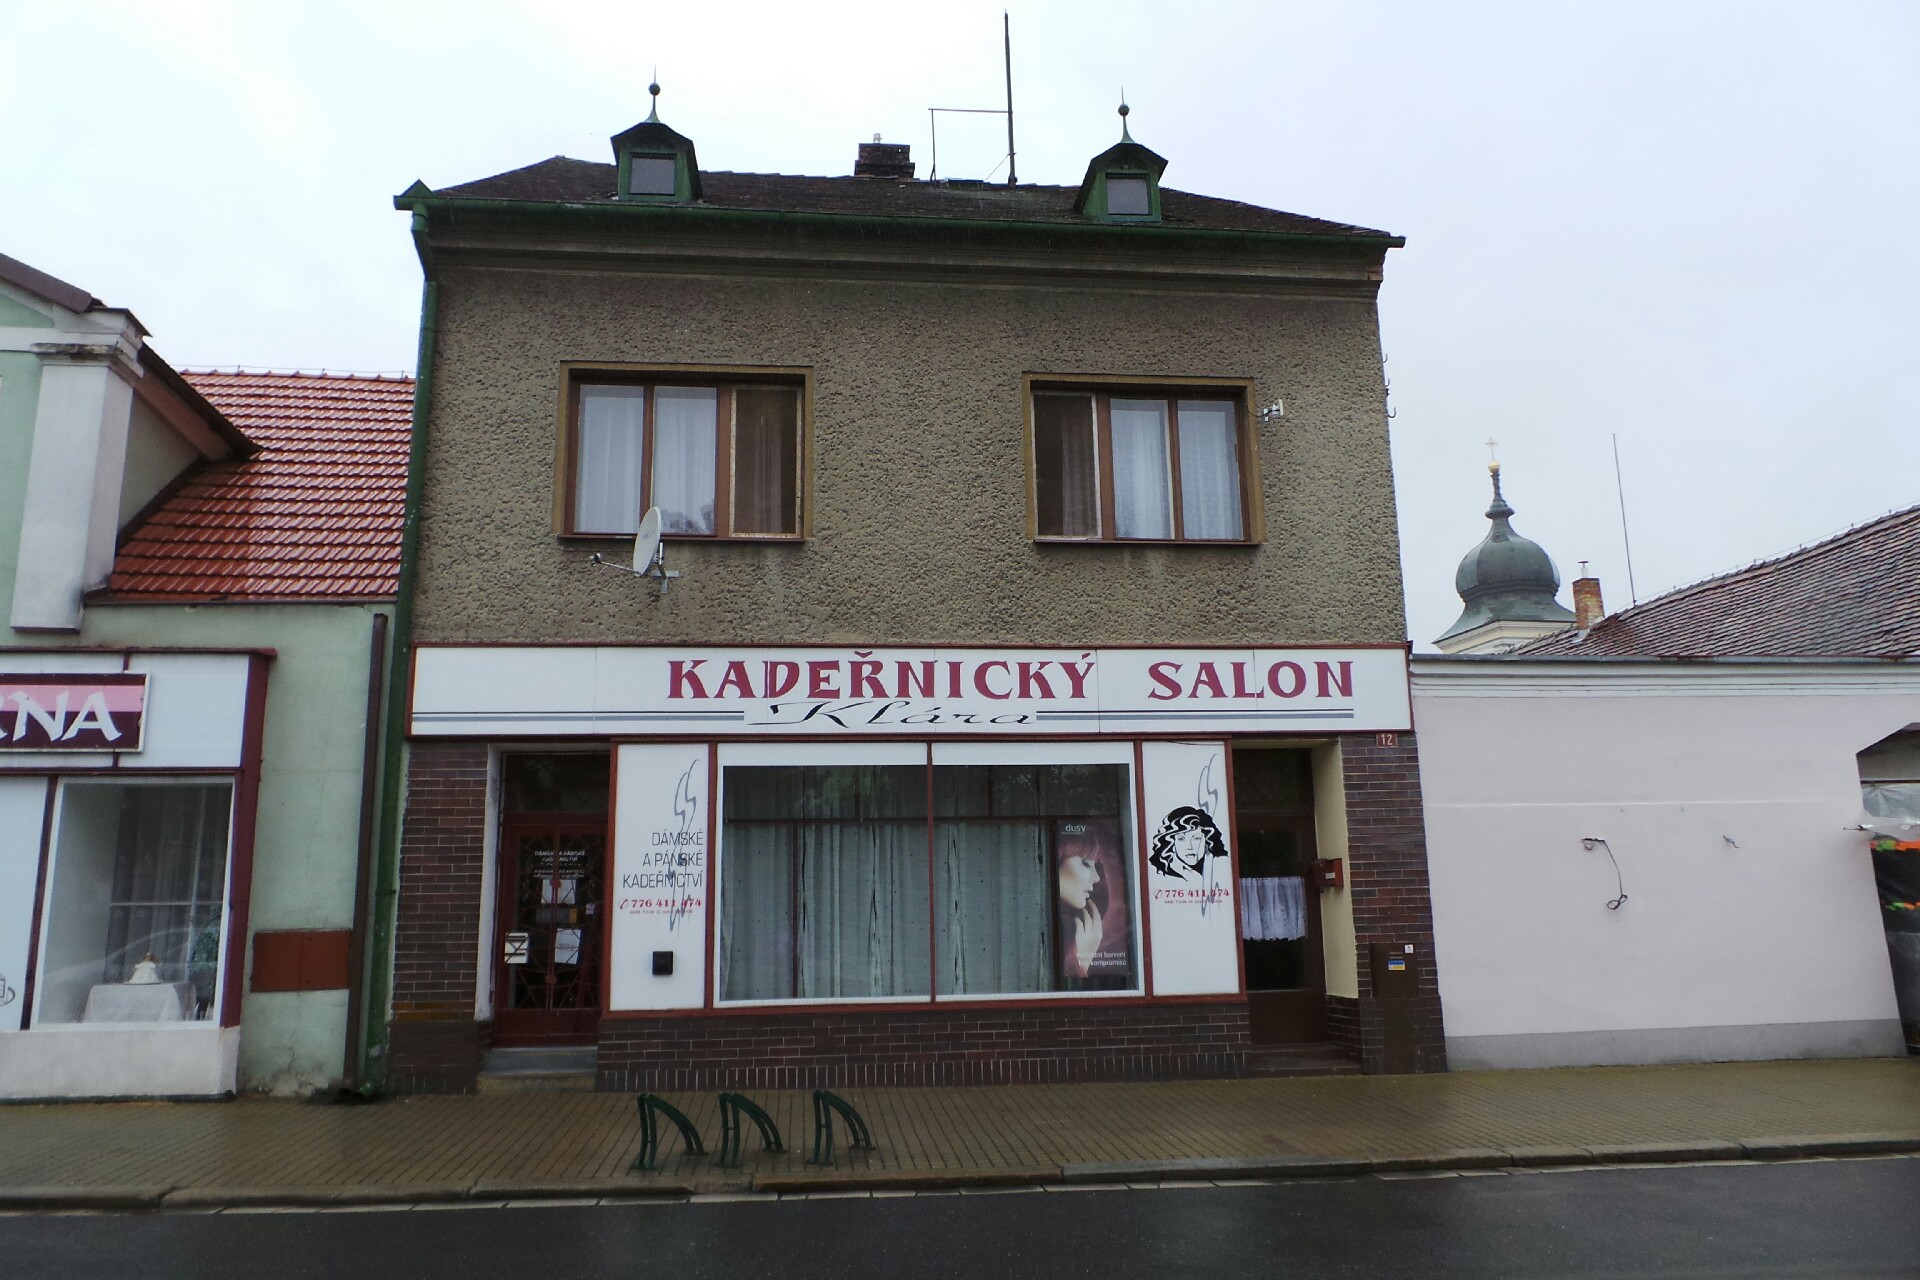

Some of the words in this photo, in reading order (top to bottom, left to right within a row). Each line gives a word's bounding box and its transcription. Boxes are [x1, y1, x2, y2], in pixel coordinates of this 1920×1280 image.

[667, 650, 1095, 699] KADEŘNICKÝ
[1148, 660, 1353, 700] SALON
[747, 701, 1034, 728] Klára
[1380, 733, 1393, 746] 12
[1065, 823, 1086, 834] dusy
[651, 828, 704, 846] DÁMSKÉ
[642, 853, 651, 866] A
[654, 849, 703, 867] PÁNSKÉ
[1164, 889, 1184, 898] 776
[1187, 889, 1206, 897] 411
[1210, 888, 1230, 897] 474
[631, 899, 653, 908] 776
[656, 898, 676, 907] 411
